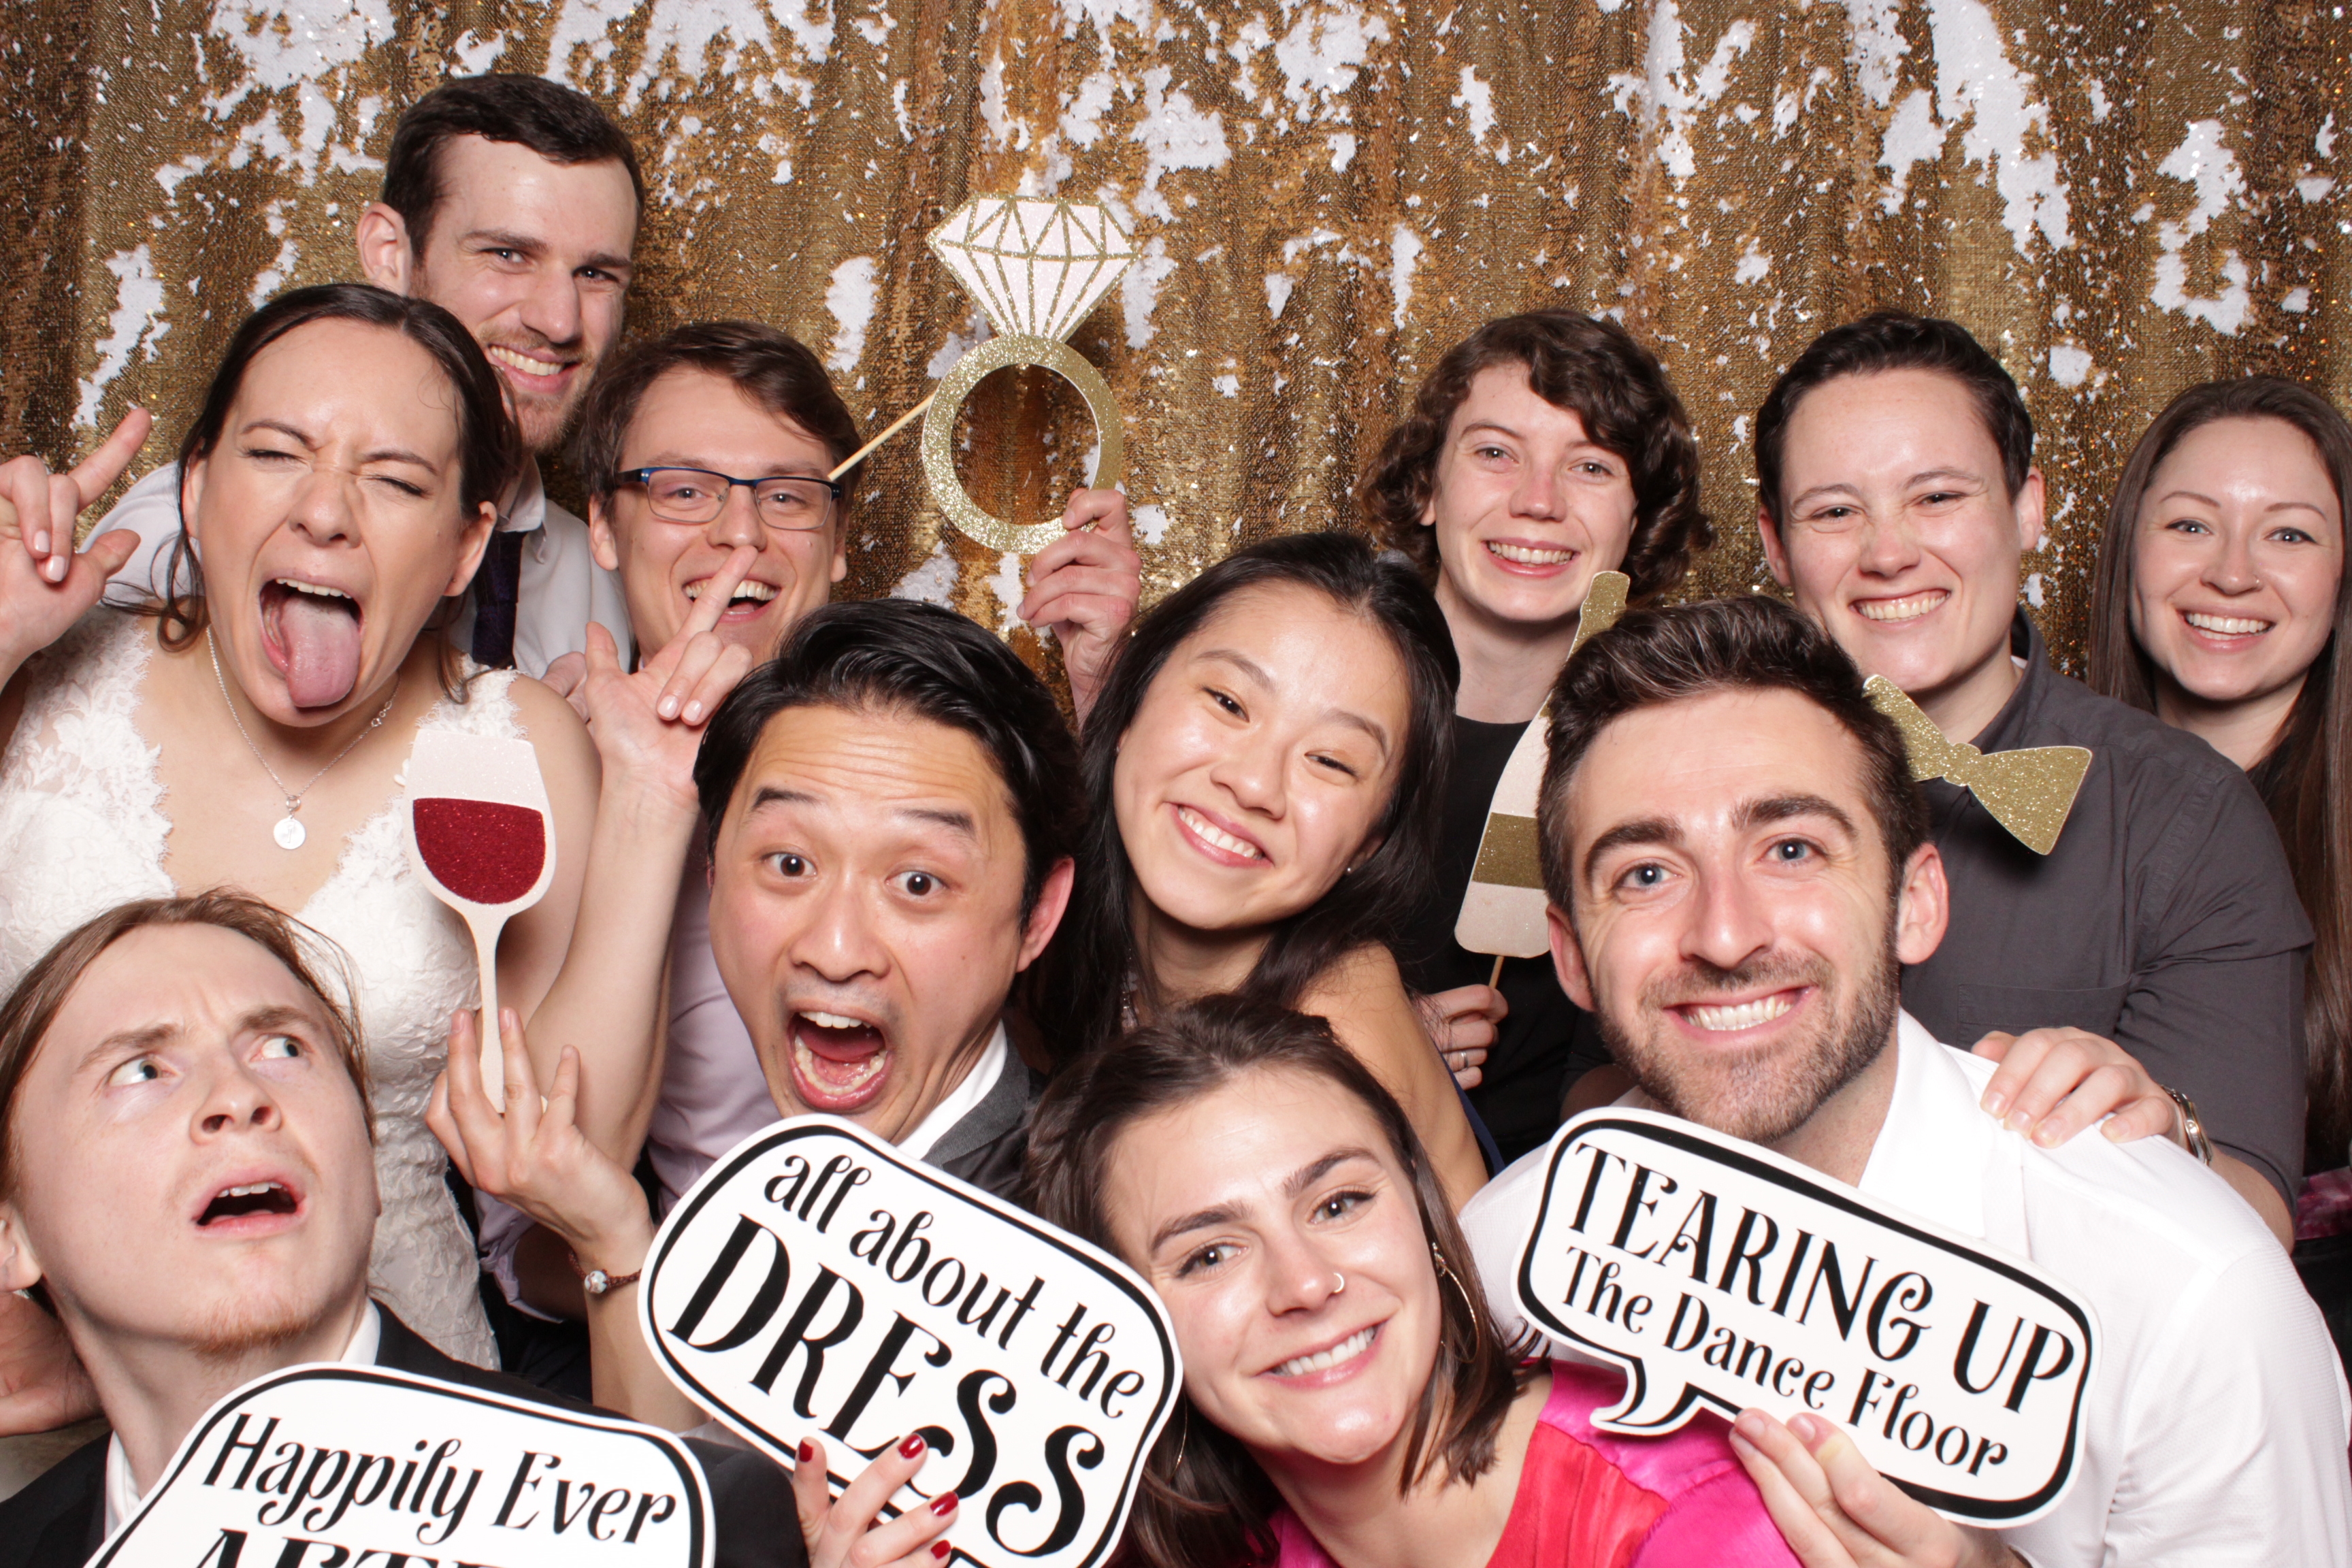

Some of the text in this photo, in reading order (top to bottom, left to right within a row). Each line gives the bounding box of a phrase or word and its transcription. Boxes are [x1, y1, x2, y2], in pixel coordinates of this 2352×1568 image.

[666, 1213, 1105, 1558] DRESS
[764, 1154, 1145, 1419] all about the
[1563, 1245, 2008, 1477] The Dance Floor
[1568, 1142, 2075, 1414] TEARING UP
[202, 1413, 676, 1546] Happily Ever
